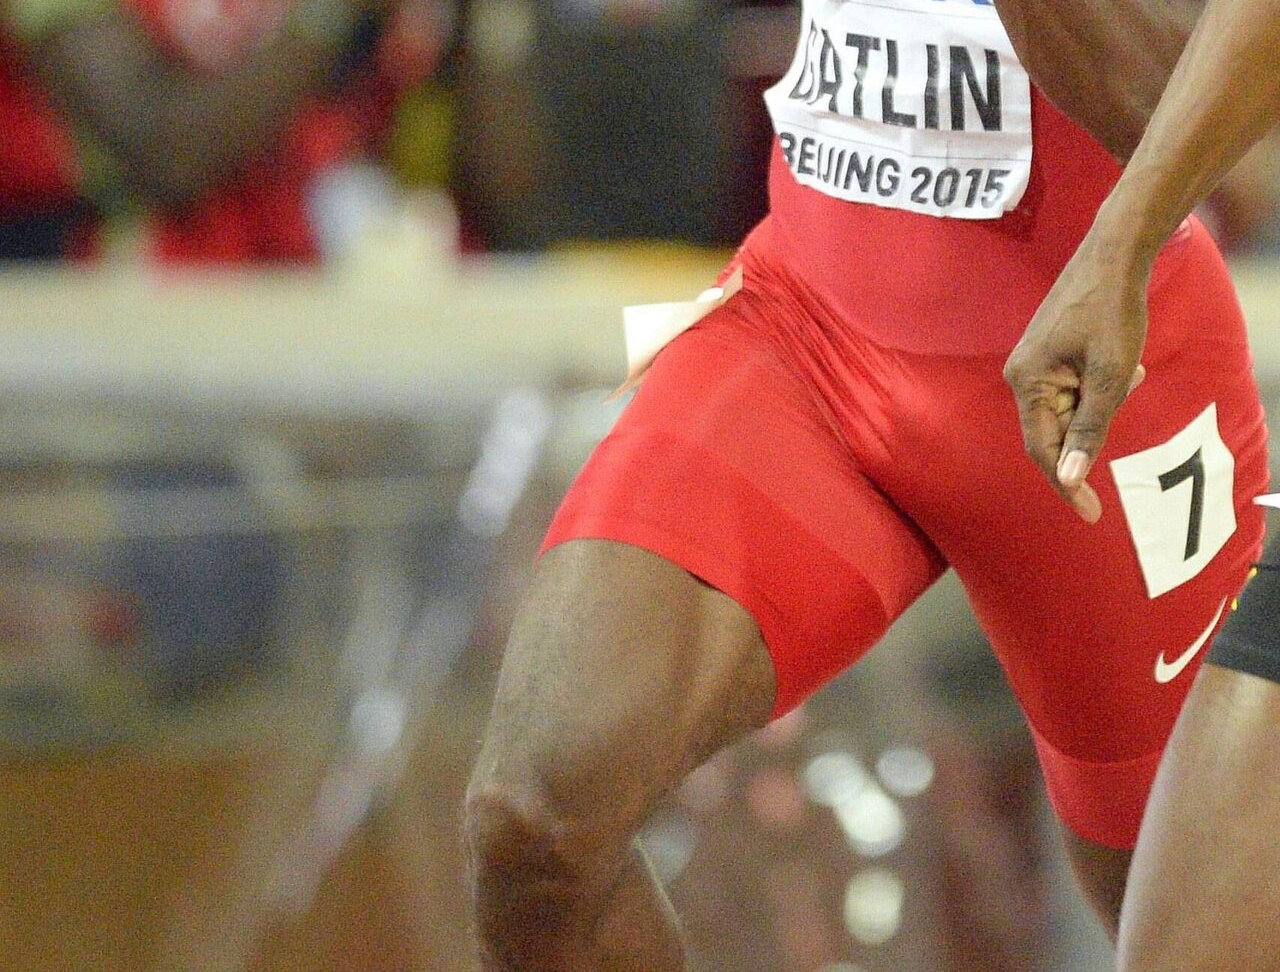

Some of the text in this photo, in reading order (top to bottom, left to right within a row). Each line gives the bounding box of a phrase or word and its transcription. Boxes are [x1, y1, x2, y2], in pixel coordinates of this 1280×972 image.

[788, 17, 1002, 131] GATLIN
[779, 131, 1011, 209] BEIJING 2015
[1157, 446, 1206, 562] 7
